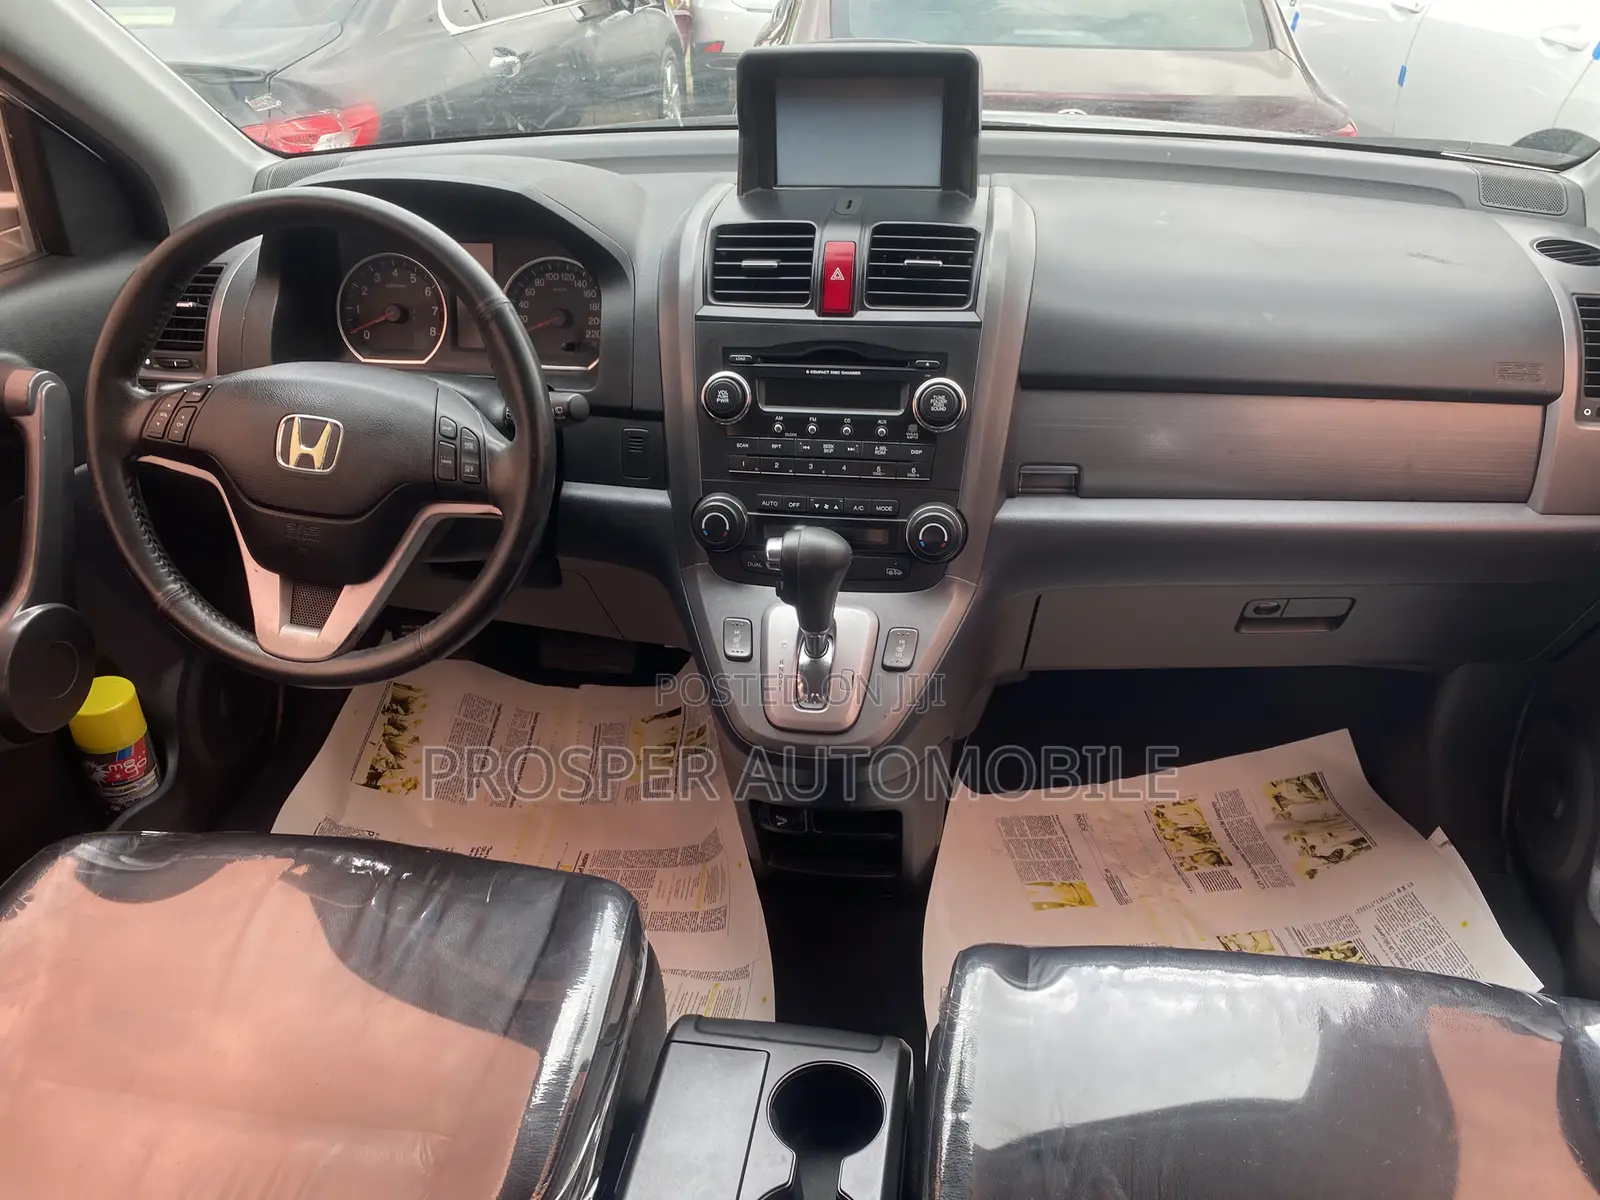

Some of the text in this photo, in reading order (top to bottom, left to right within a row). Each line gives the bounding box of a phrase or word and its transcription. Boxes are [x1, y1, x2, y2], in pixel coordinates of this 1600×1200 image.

[374, 273, 381, 282] 3
[391, 269, 399, 278] 4
[410, 273, 417, 283] 5
[545, 272, 559, 280] 100
[561, 272, 575, 281] 120
[534, 278, 545, 287] 80
[574, 280, 588, 288] 140
[361, 286, 368, 296] 2
[424, 286, 432, 297] 6
[525, 288, 536, 296] 60
[583, 289, 597, 298] 160
[518, 300, 529, 309] 40
[431, 306, 439, 316] 7
[363, 329, 371, 340] 0
[429, 326, 437, 337] 8
